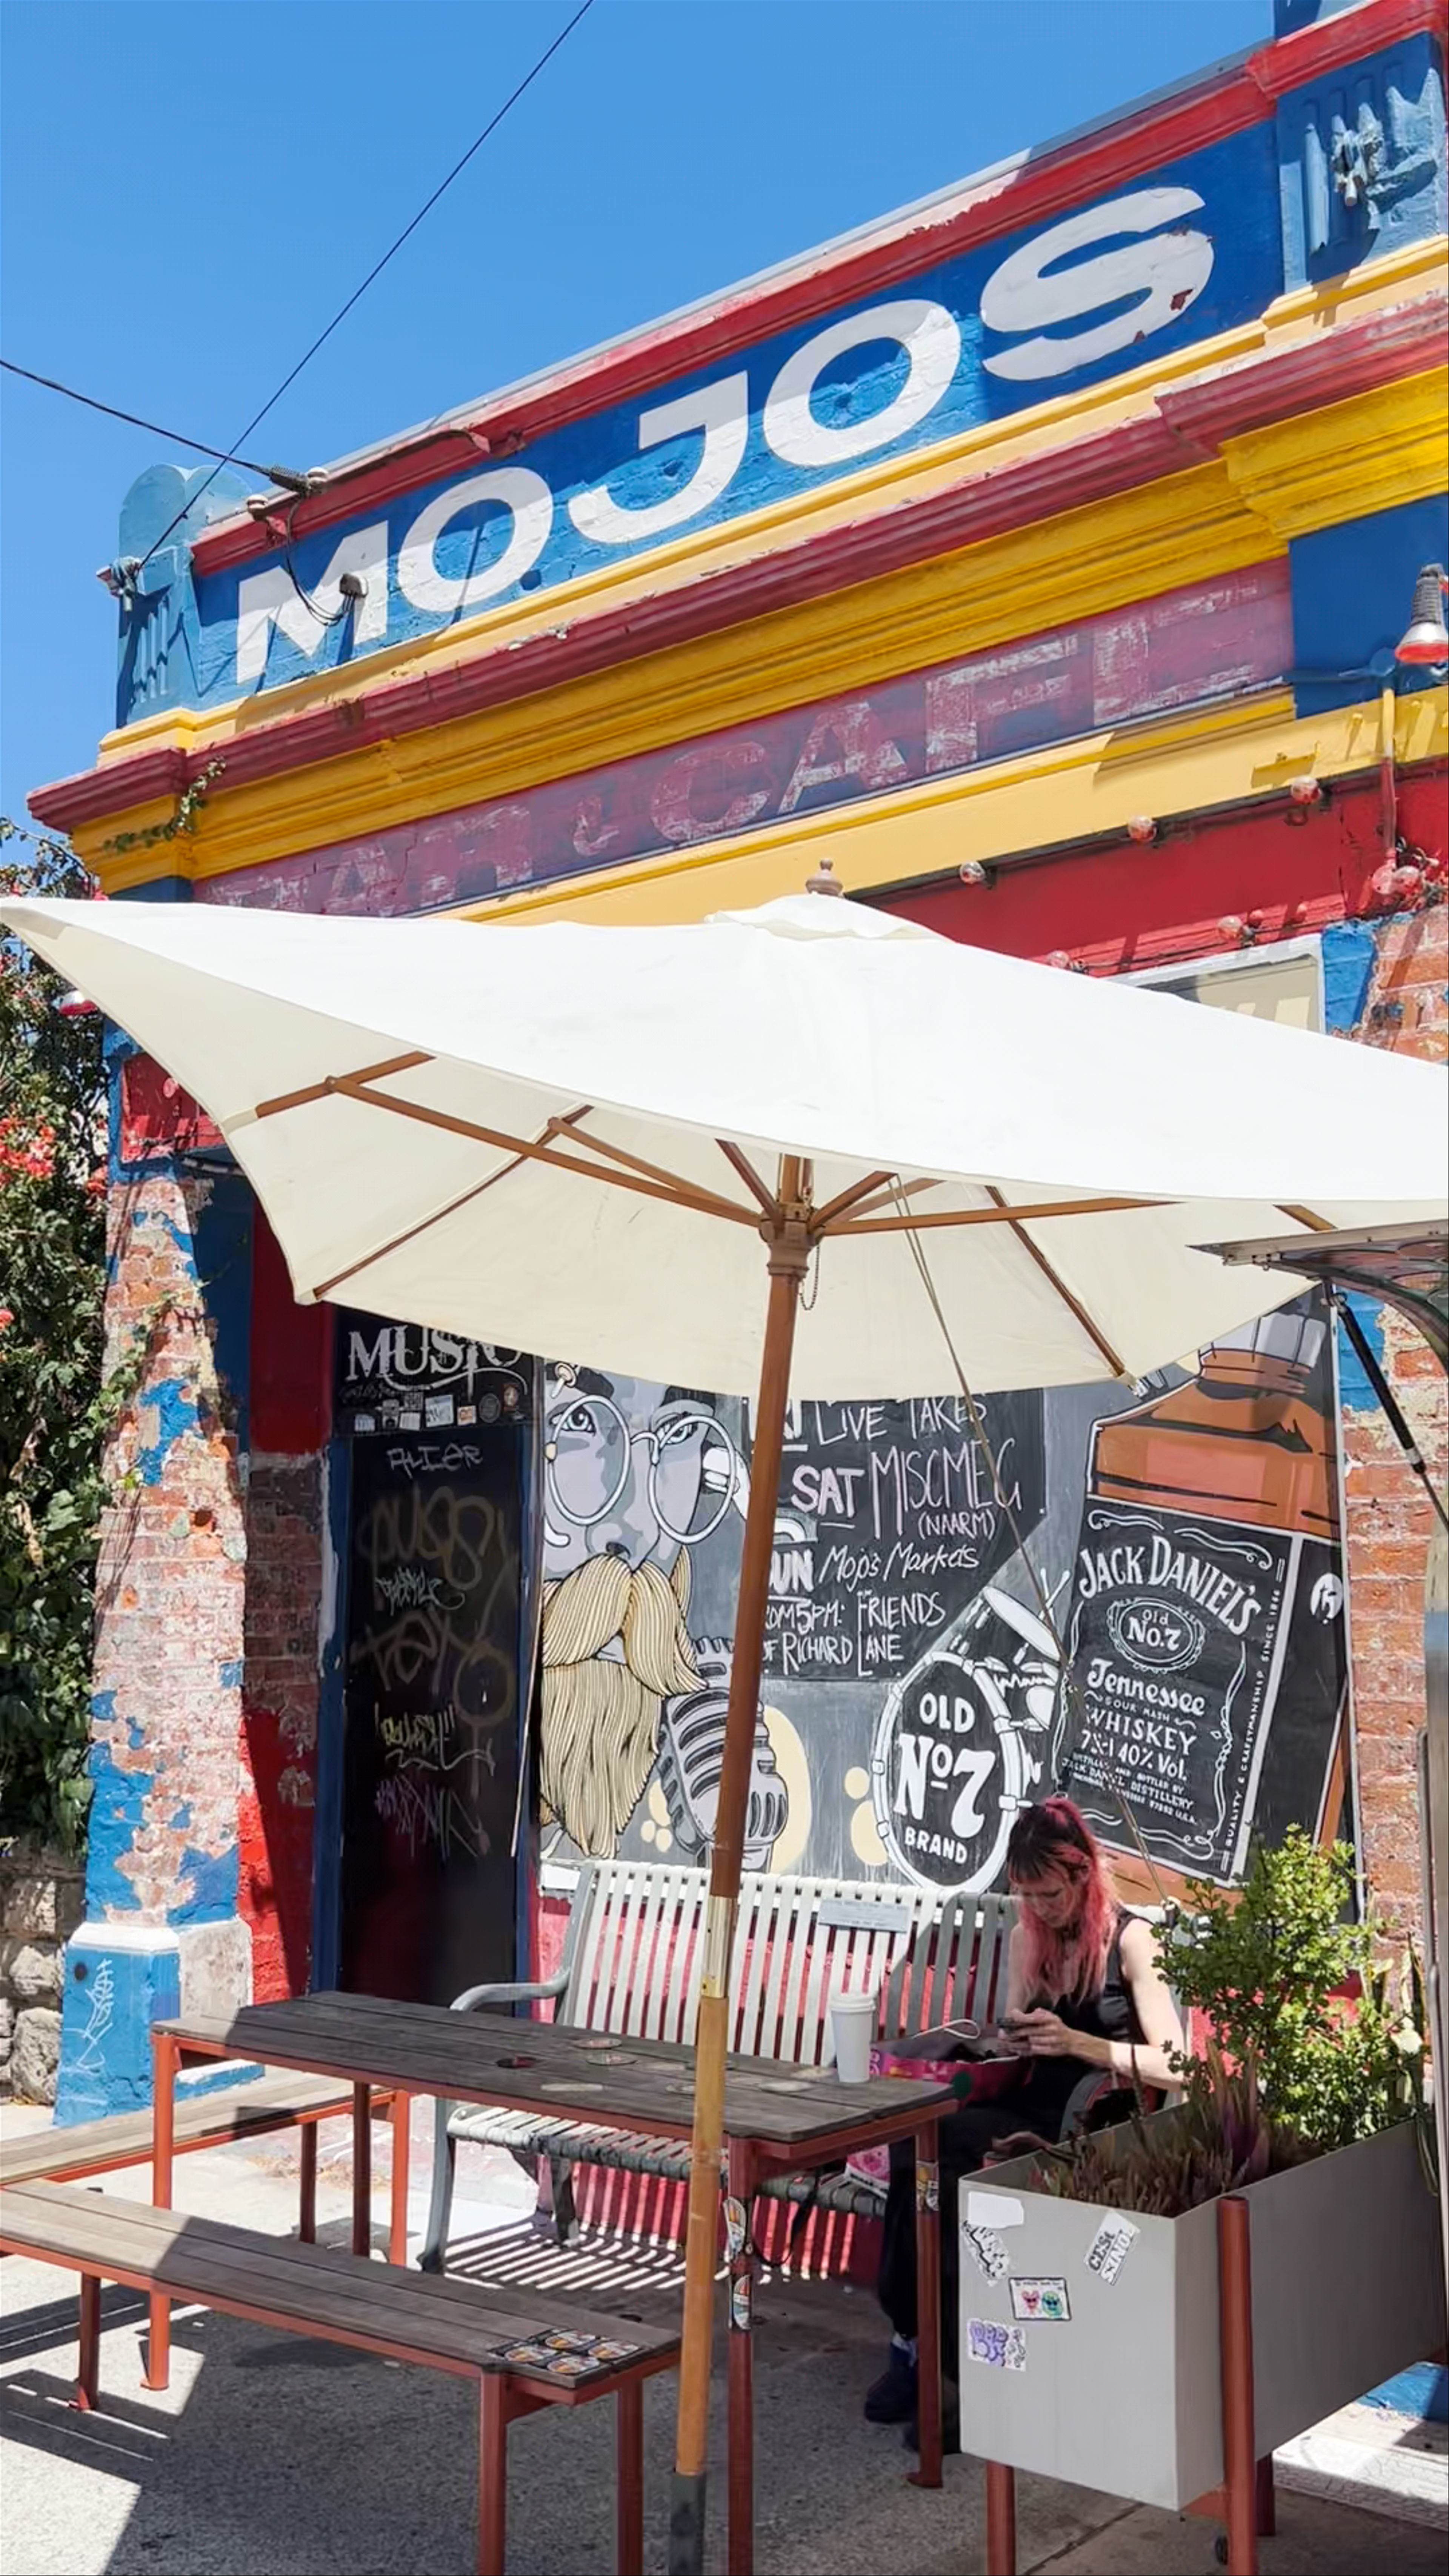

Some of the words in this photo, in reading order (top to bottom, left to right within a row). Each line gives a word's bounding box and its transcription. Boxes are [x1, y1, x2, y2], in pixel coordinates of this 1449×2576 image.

[237, 188, 1214, 684] MOJOS
[651, 580, 1261, 844] CAFE
[815, 1400, 888, 1445] LIVE
[791, 1464, 866, 1518] SAT
[918, 1511, 995, 1541] (NAARM)
[769, 1549, 814, 1595] UN
[1079, 1546, 1145, 1599] JACK
[1147, 1534, 1262, 1636] DANIEL'S
[856, 1589, 946, 1631] FRIENDS
[782, 1632, 854, 1676] RICHARD
[858, 1631, 905, 1676] LANE
[919, 1692, 976, 1734] OLD
[904, 1825, 968, 1865] BRAND
